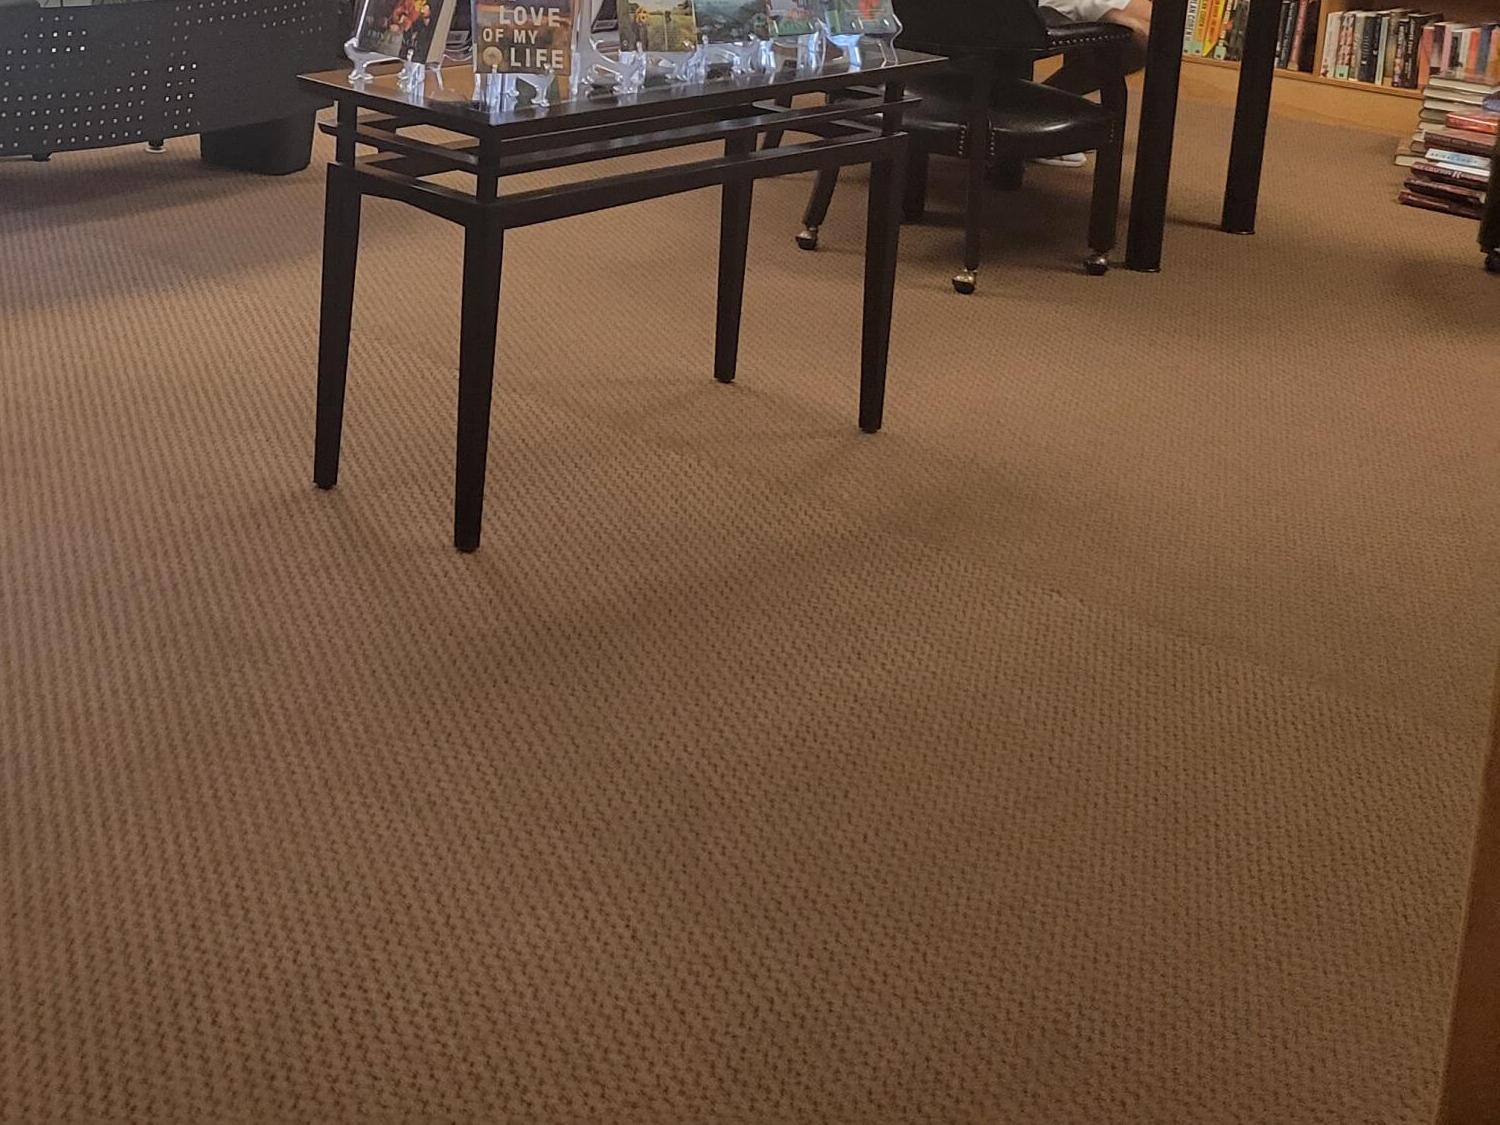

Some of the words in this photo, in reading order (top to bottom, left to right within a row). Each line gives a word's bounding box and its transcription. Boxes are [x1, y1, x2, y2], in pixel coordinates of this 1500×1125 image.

[499, 5, 561, 27] LOVE
[483, 28, 504, 43] OF
[513, 29, 539, 45] MY
[510, 46, 564, 69] LIFE
